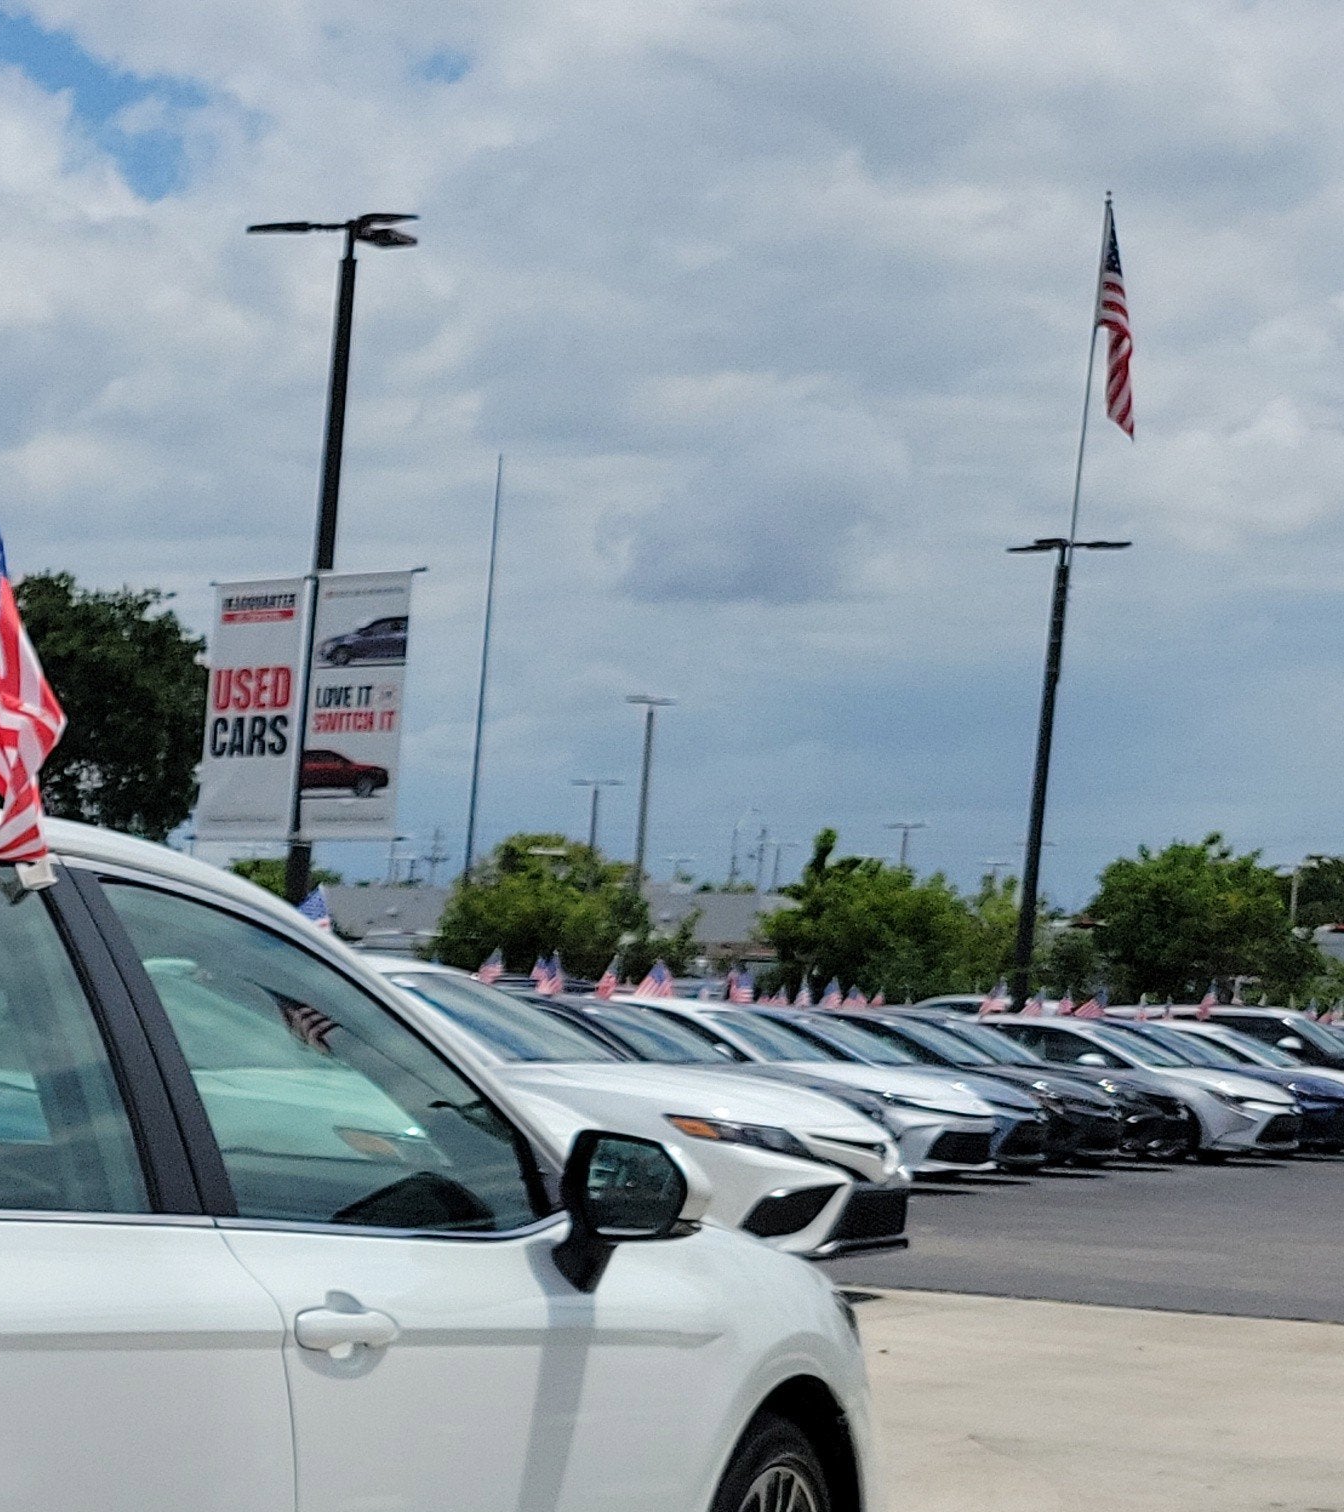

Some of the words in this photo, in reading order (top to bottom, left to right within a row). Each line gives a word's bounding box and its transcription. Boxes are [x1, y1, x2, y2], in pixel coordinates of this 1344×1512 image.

[214, 667, 291, 710] USED
[316, 685, 352, 708] LOVE
[356, 685, 373, 707] IT
[211, 715, 289, 757] CARS
[378, 710, 395, 731] IT
